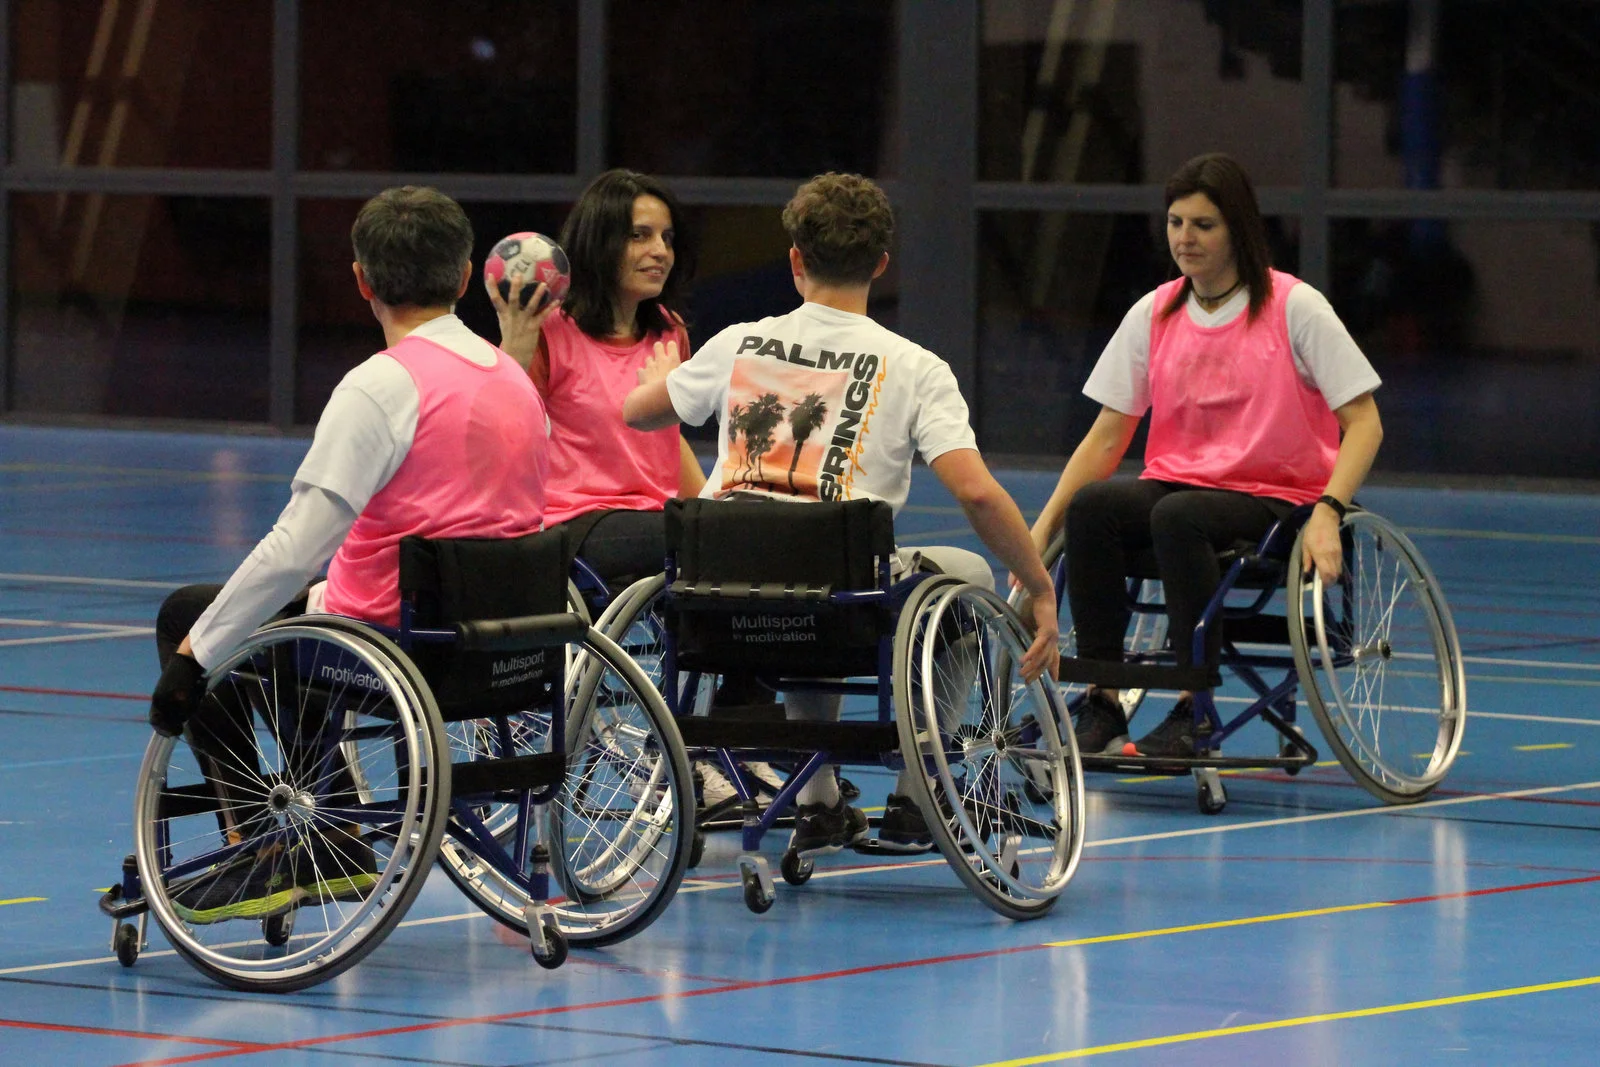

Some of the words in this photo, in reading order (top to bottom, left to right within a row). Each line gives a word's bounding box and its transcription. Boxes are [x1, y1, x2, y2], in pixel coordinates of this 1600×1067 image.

[736, 336, 856, 370] PALMS
[731, 614, 816, 630] Multisport
[745, 630, 816, 643] motivation
[492, 649, 545, 676] Multisport
